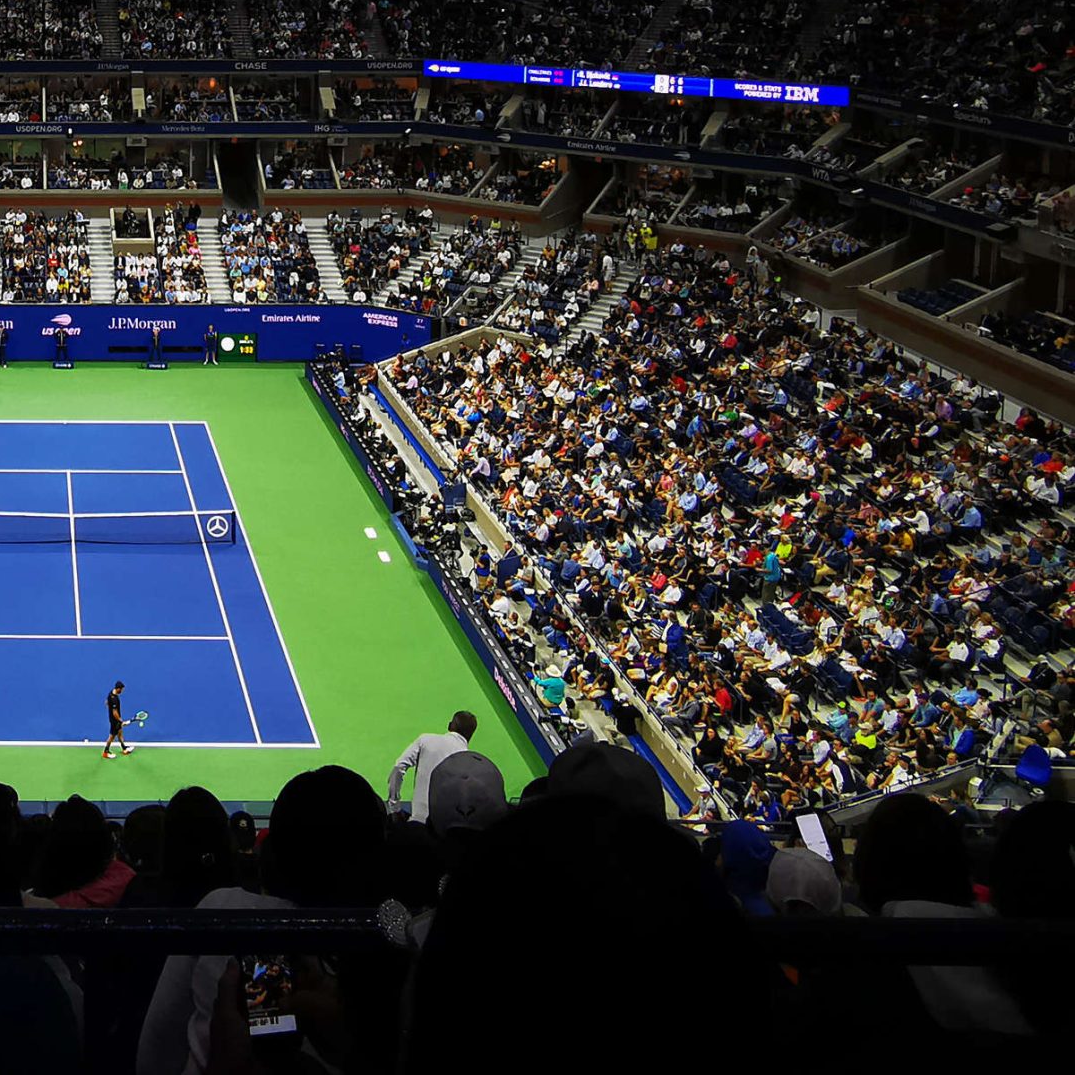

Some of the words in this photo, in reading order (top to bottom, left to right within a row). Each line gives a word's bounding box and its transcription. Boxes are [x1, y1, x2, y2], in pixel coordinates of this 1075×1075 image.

[234, 62, 268, 71] CHASE
[367, 62, 413, 70] USOPEN.ORG
[670, 77, 675, 85] 6
[678, 77, 683, 85] 6
[784, 85, 819, 102] IBM
[15, 125, 63, 133] USOPEN.ORG
[261, 314, 294, 323] Emirates
[295, 314, 321, 323] Airline
[362, 312, 398, 323] AMERICAN
[108, 316, 177, 332] J.P.Morgan
[367, 318, 398, 328] EXPRESS
[41, 327, 54, 336] us
